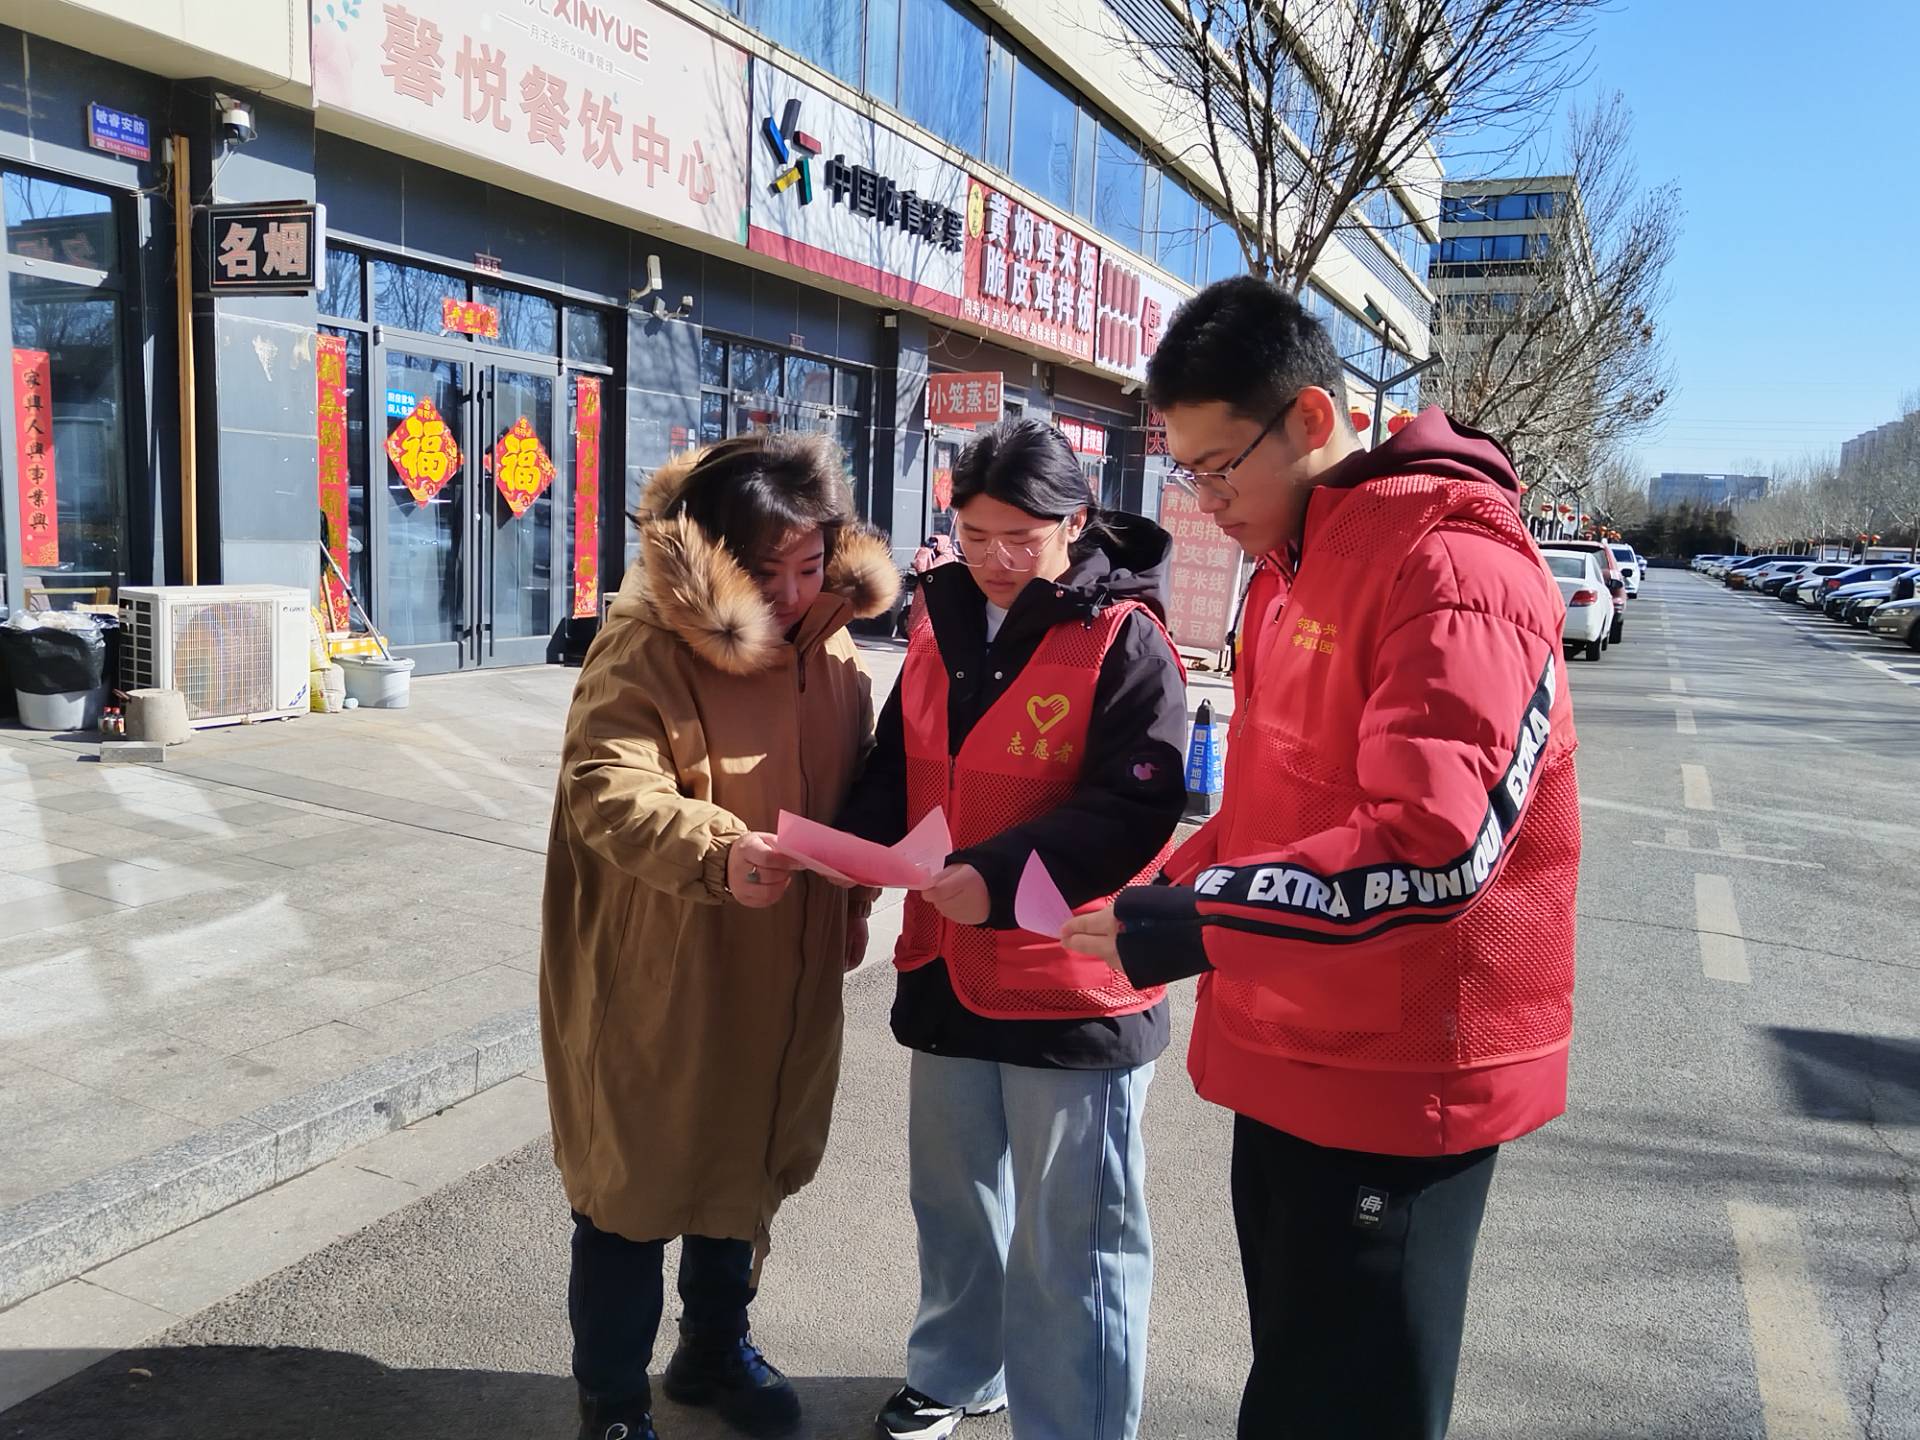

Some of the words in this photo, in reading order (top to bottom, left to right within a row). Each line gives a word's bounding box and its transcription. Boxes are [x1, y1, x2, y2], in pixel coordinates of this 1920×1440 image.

[553, 0, 649, 62] XINYUE
[380, 5, 717, 206] 馨悦餐饮中心
[824, 154, 965, 252] 中国体育彩票
[218, 222, 307, 278] 名烟
[986, 192, 1097, 291] 黄焖鸡米饭
[983, 244, 1095, 333] 脆皮鸡拌饭
[931, 381, 999, 414] 小笼蒸包
[400, 415, 448, 482] 福
[500, 433, 541, 494] 福
[1189, 620, 1220, 642] 豆浆
[1007, 731, 1074, 764] 志愿者
[1247, 867, 1351, 919] EXTRA
[1364, 868, 1409, 911] BE
[1505, 707, 1552, 812] EXTRA
